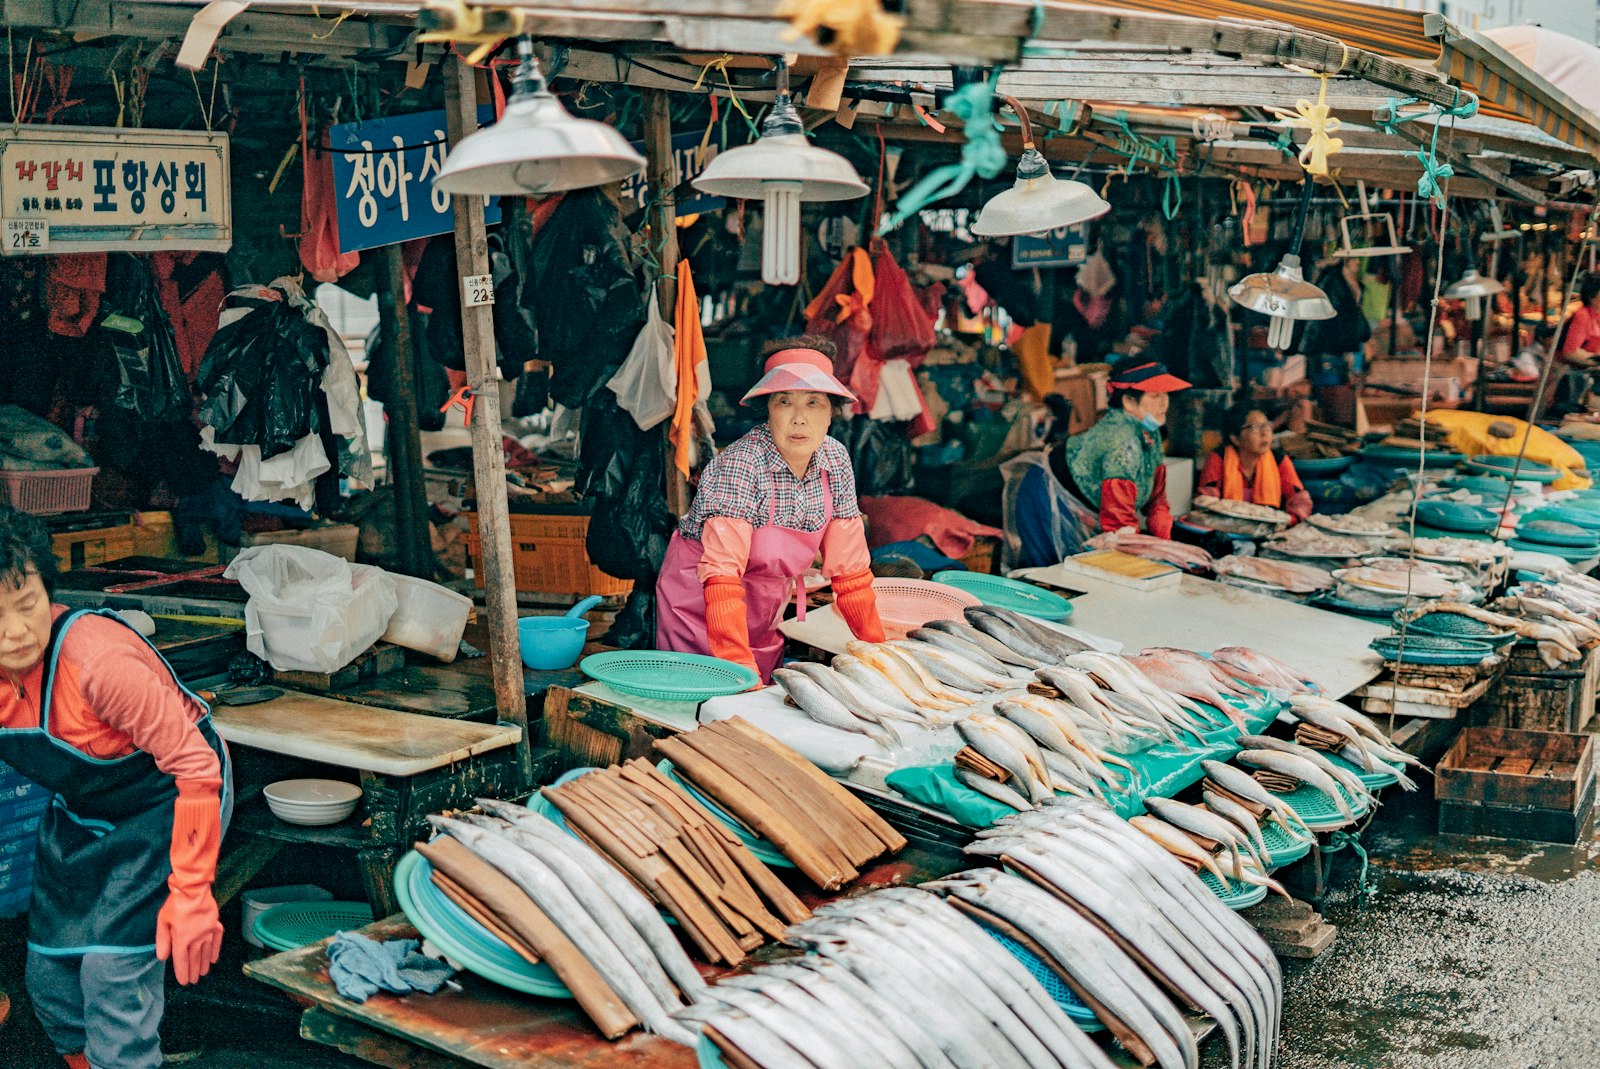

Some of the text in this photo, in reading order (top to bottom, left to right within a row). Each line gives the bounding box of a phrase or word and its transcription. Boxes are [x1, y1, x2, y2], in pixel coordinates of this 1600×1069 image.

[15, 158, 207, 214] 자갈치 포항상회
[13, 232, 41, 248] 21호
